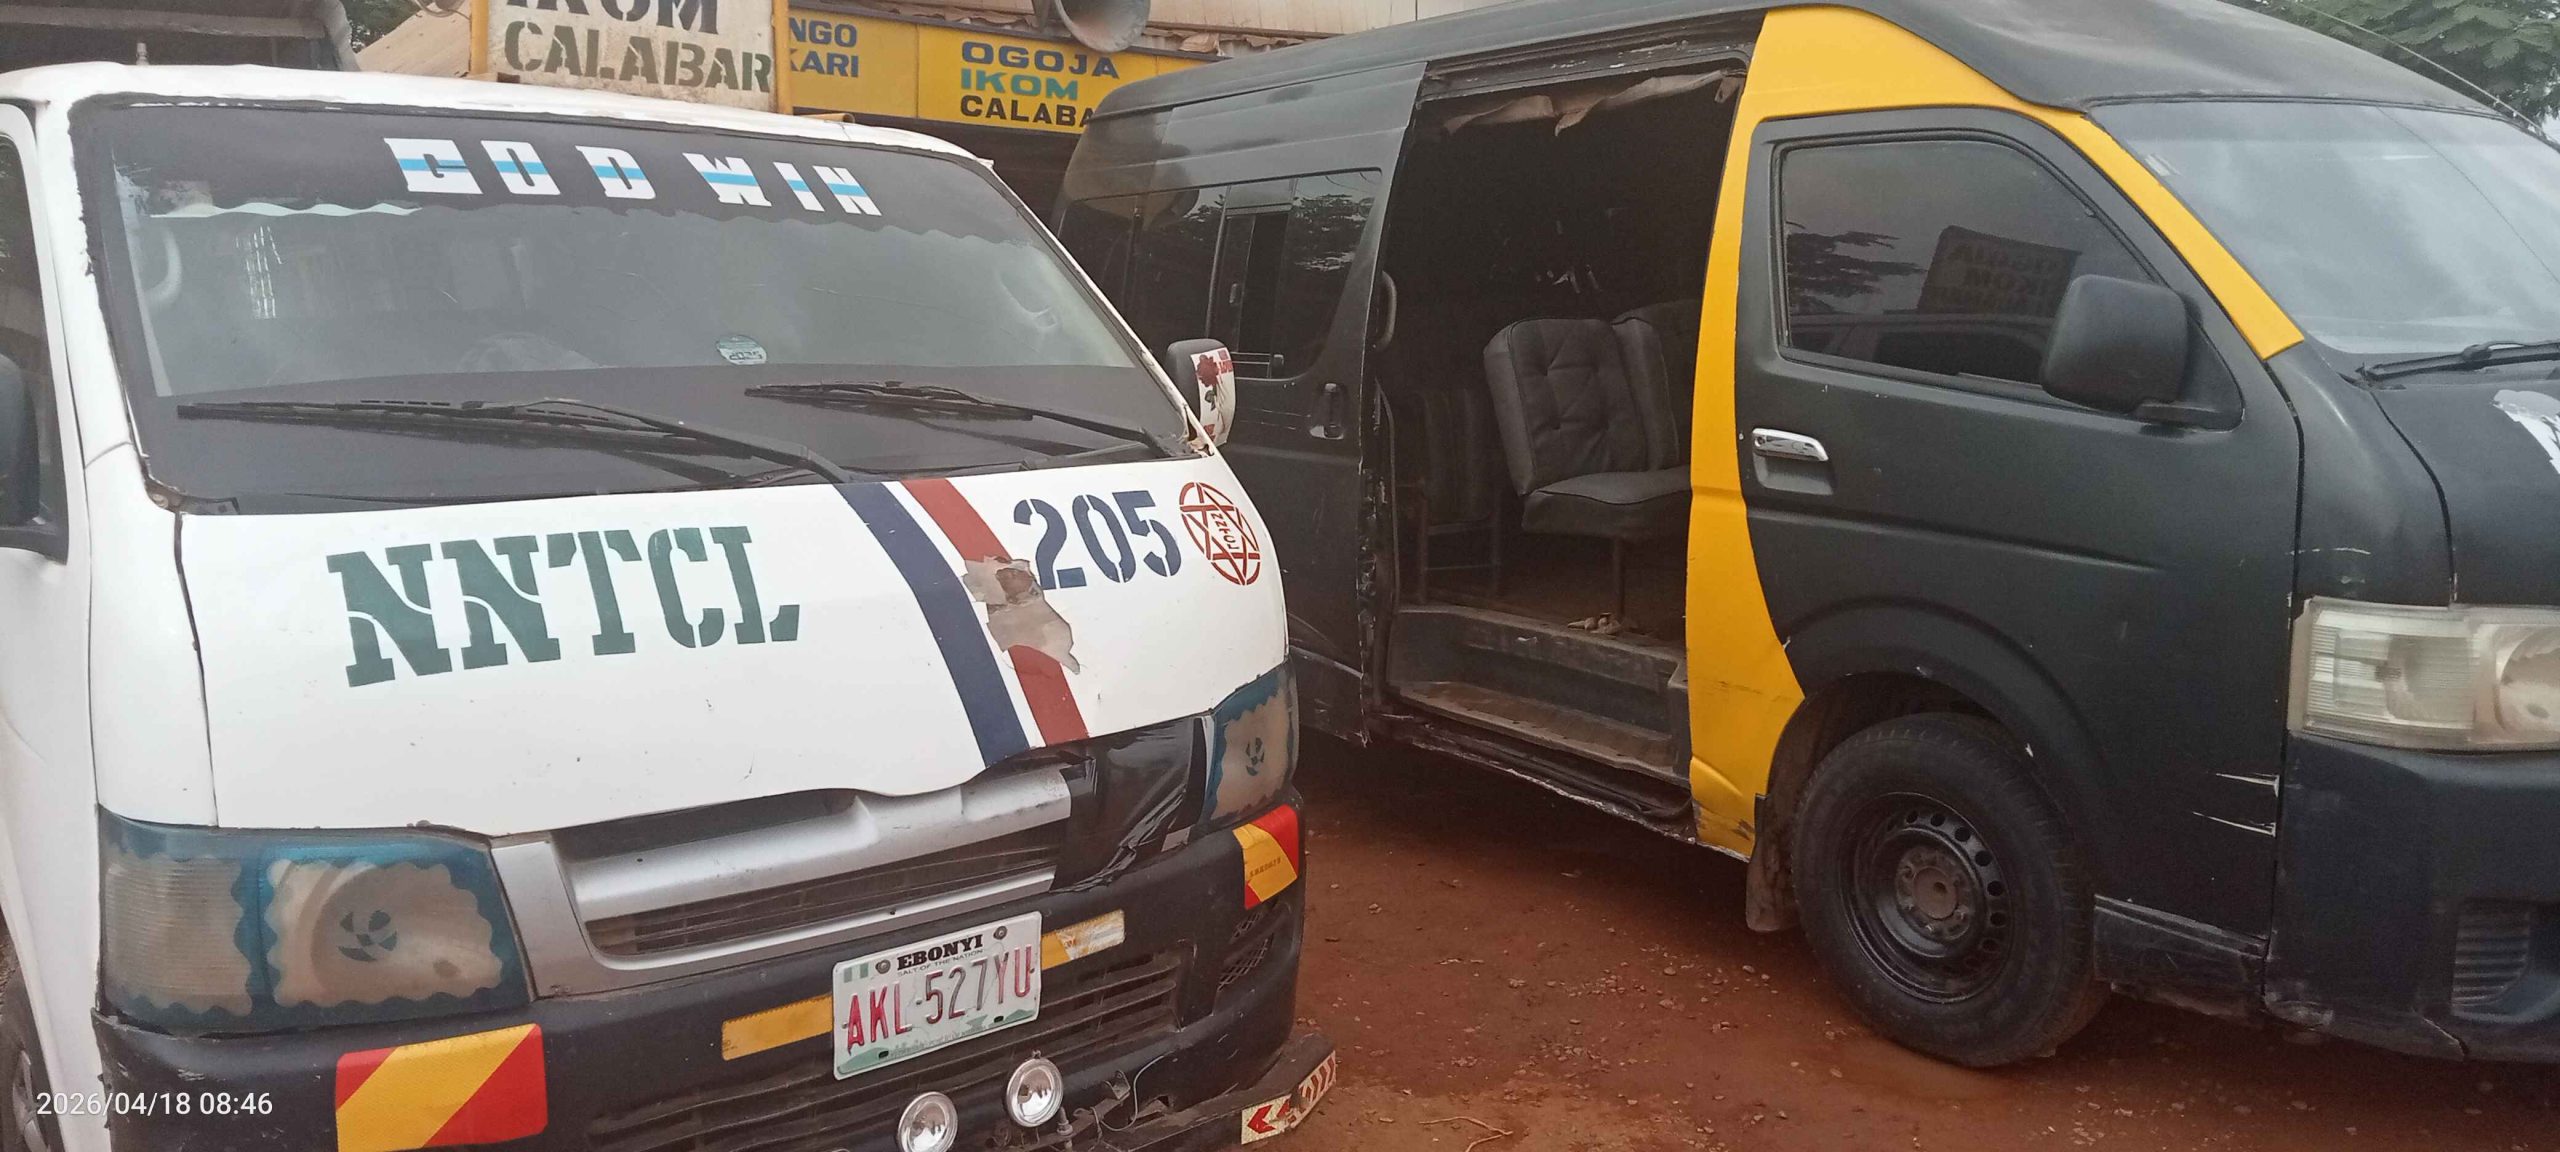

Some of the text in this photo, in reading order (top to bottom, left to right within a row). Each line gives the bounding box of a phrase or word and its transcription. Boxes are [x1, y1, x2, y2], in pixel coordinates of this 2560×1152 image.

[504, 20, 771, 93] CALABAR
[962, 41, 1119, 80] OGOJA
[961, 68, 1078, 101] IKOM
[1013, 490, 1182, 590] 205
[326, 525, 801, 688] NNTCL
[897, 934, 984, 971] EBONYI
[920, 962, 932, 972] OF
[934, 958, 950, 968] THE
[952, 948, 984, 962] NATION
